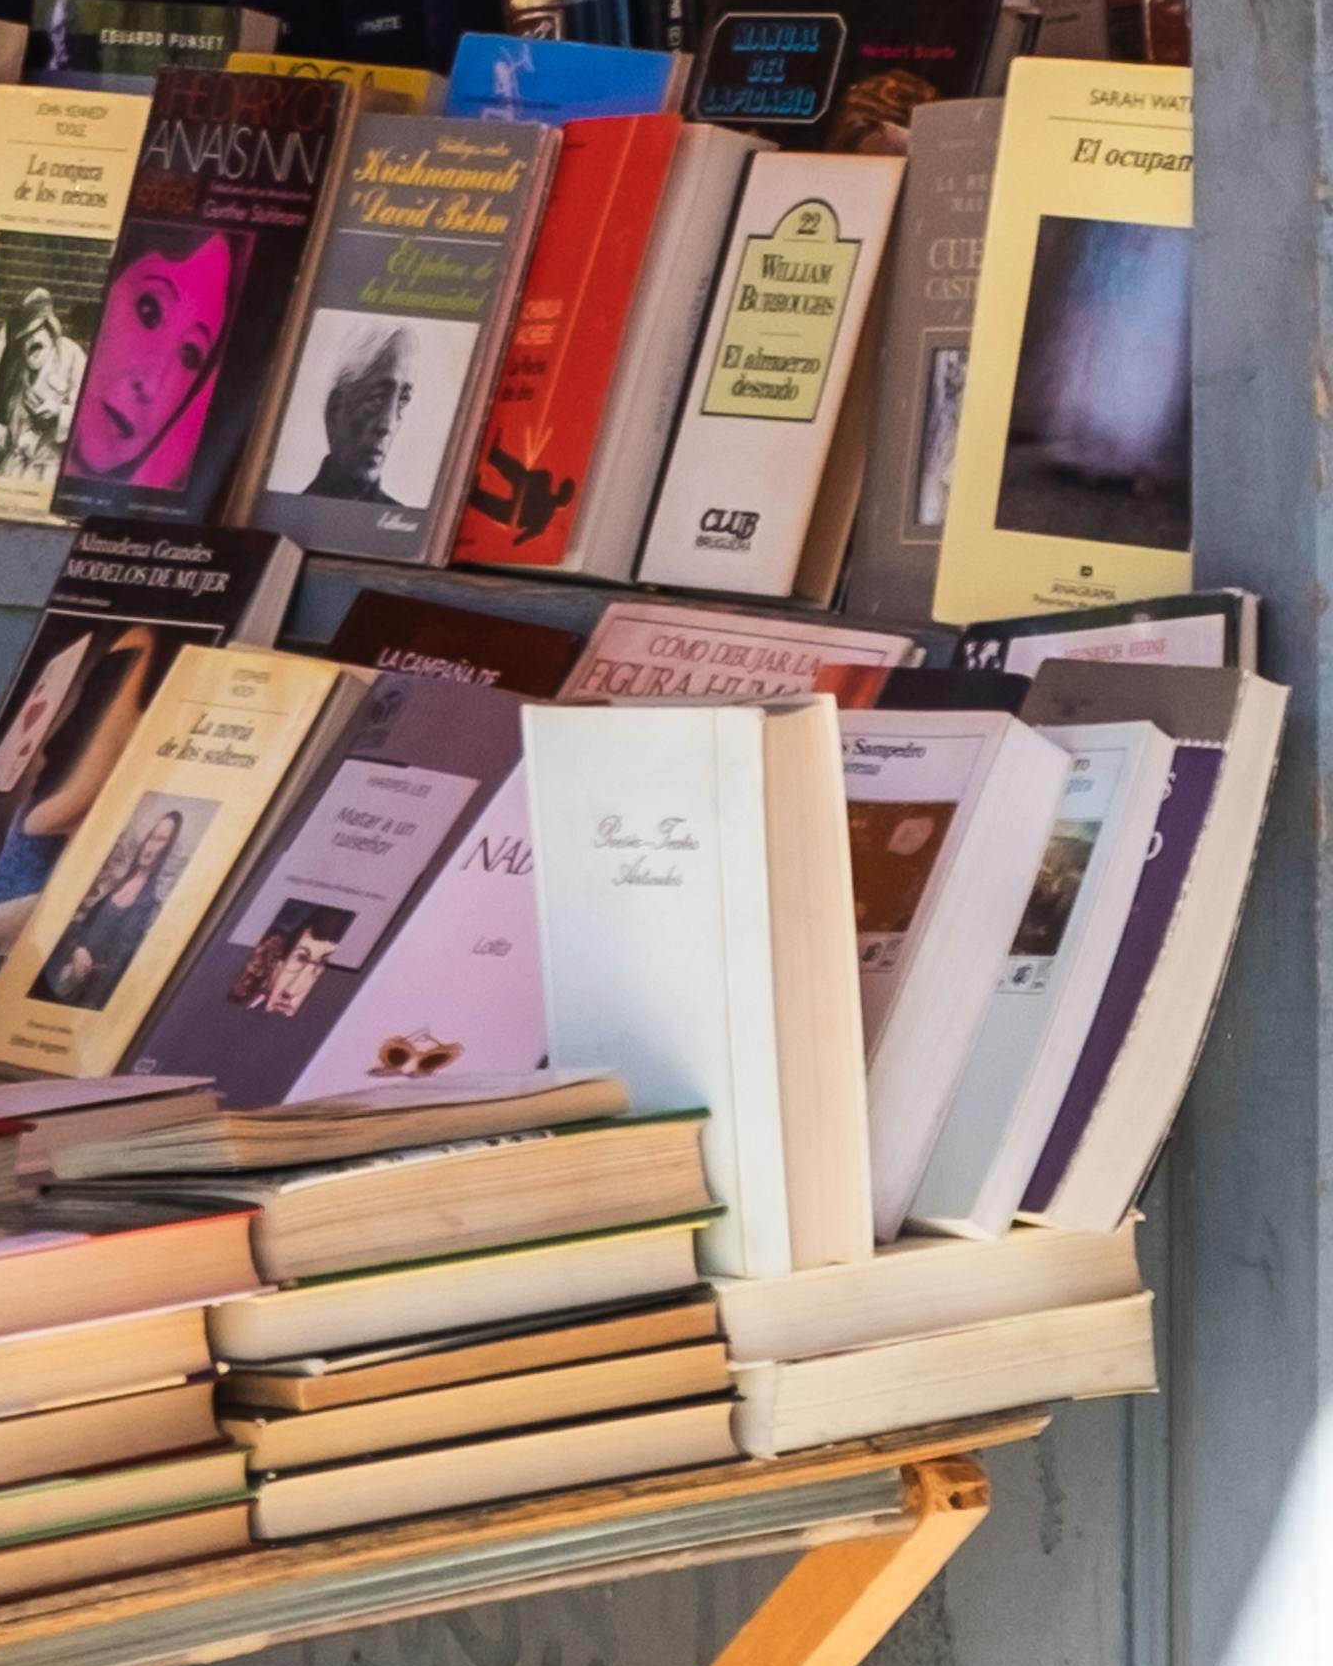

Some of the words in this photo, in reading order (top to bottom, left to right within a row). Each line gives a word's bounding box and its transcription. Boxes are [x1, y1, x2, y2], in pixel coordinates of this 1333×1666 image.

[99, 28, 164, 46] EDUARDO
[168, 32, 225, 51] PUNSET
[731, 23, 820, 52] MANUAL
[747, 58, 787, 83] DEL
[1089, 88, 1146, 109] SARAH
[1070, 137, 1102, 164] El
[26, 153, 47, 177] La
[49, 160, 104, 184] conjura
[13, 182, 33, 202] de
[35, 180, 56, 203] los
[796, 211, 823, 235] 22
[759, 253, 834, 285] WILLIAM
[720, 343, 740, 370] El
[699, 508, 760, 539] CLUB
[63, 558, 146, 587] MODELOS
[147, 565, 170, 588] DE
[174, 569, 231, 597] MUJER
[378, 646, 398, 668] LA
[647, 633, 711, 662] CÓMO
[710, 642, 792, 675] DIBUJAR
[579, 658, 695, 697] FIGURA
[852, 738, 927, 761] Sampedro
